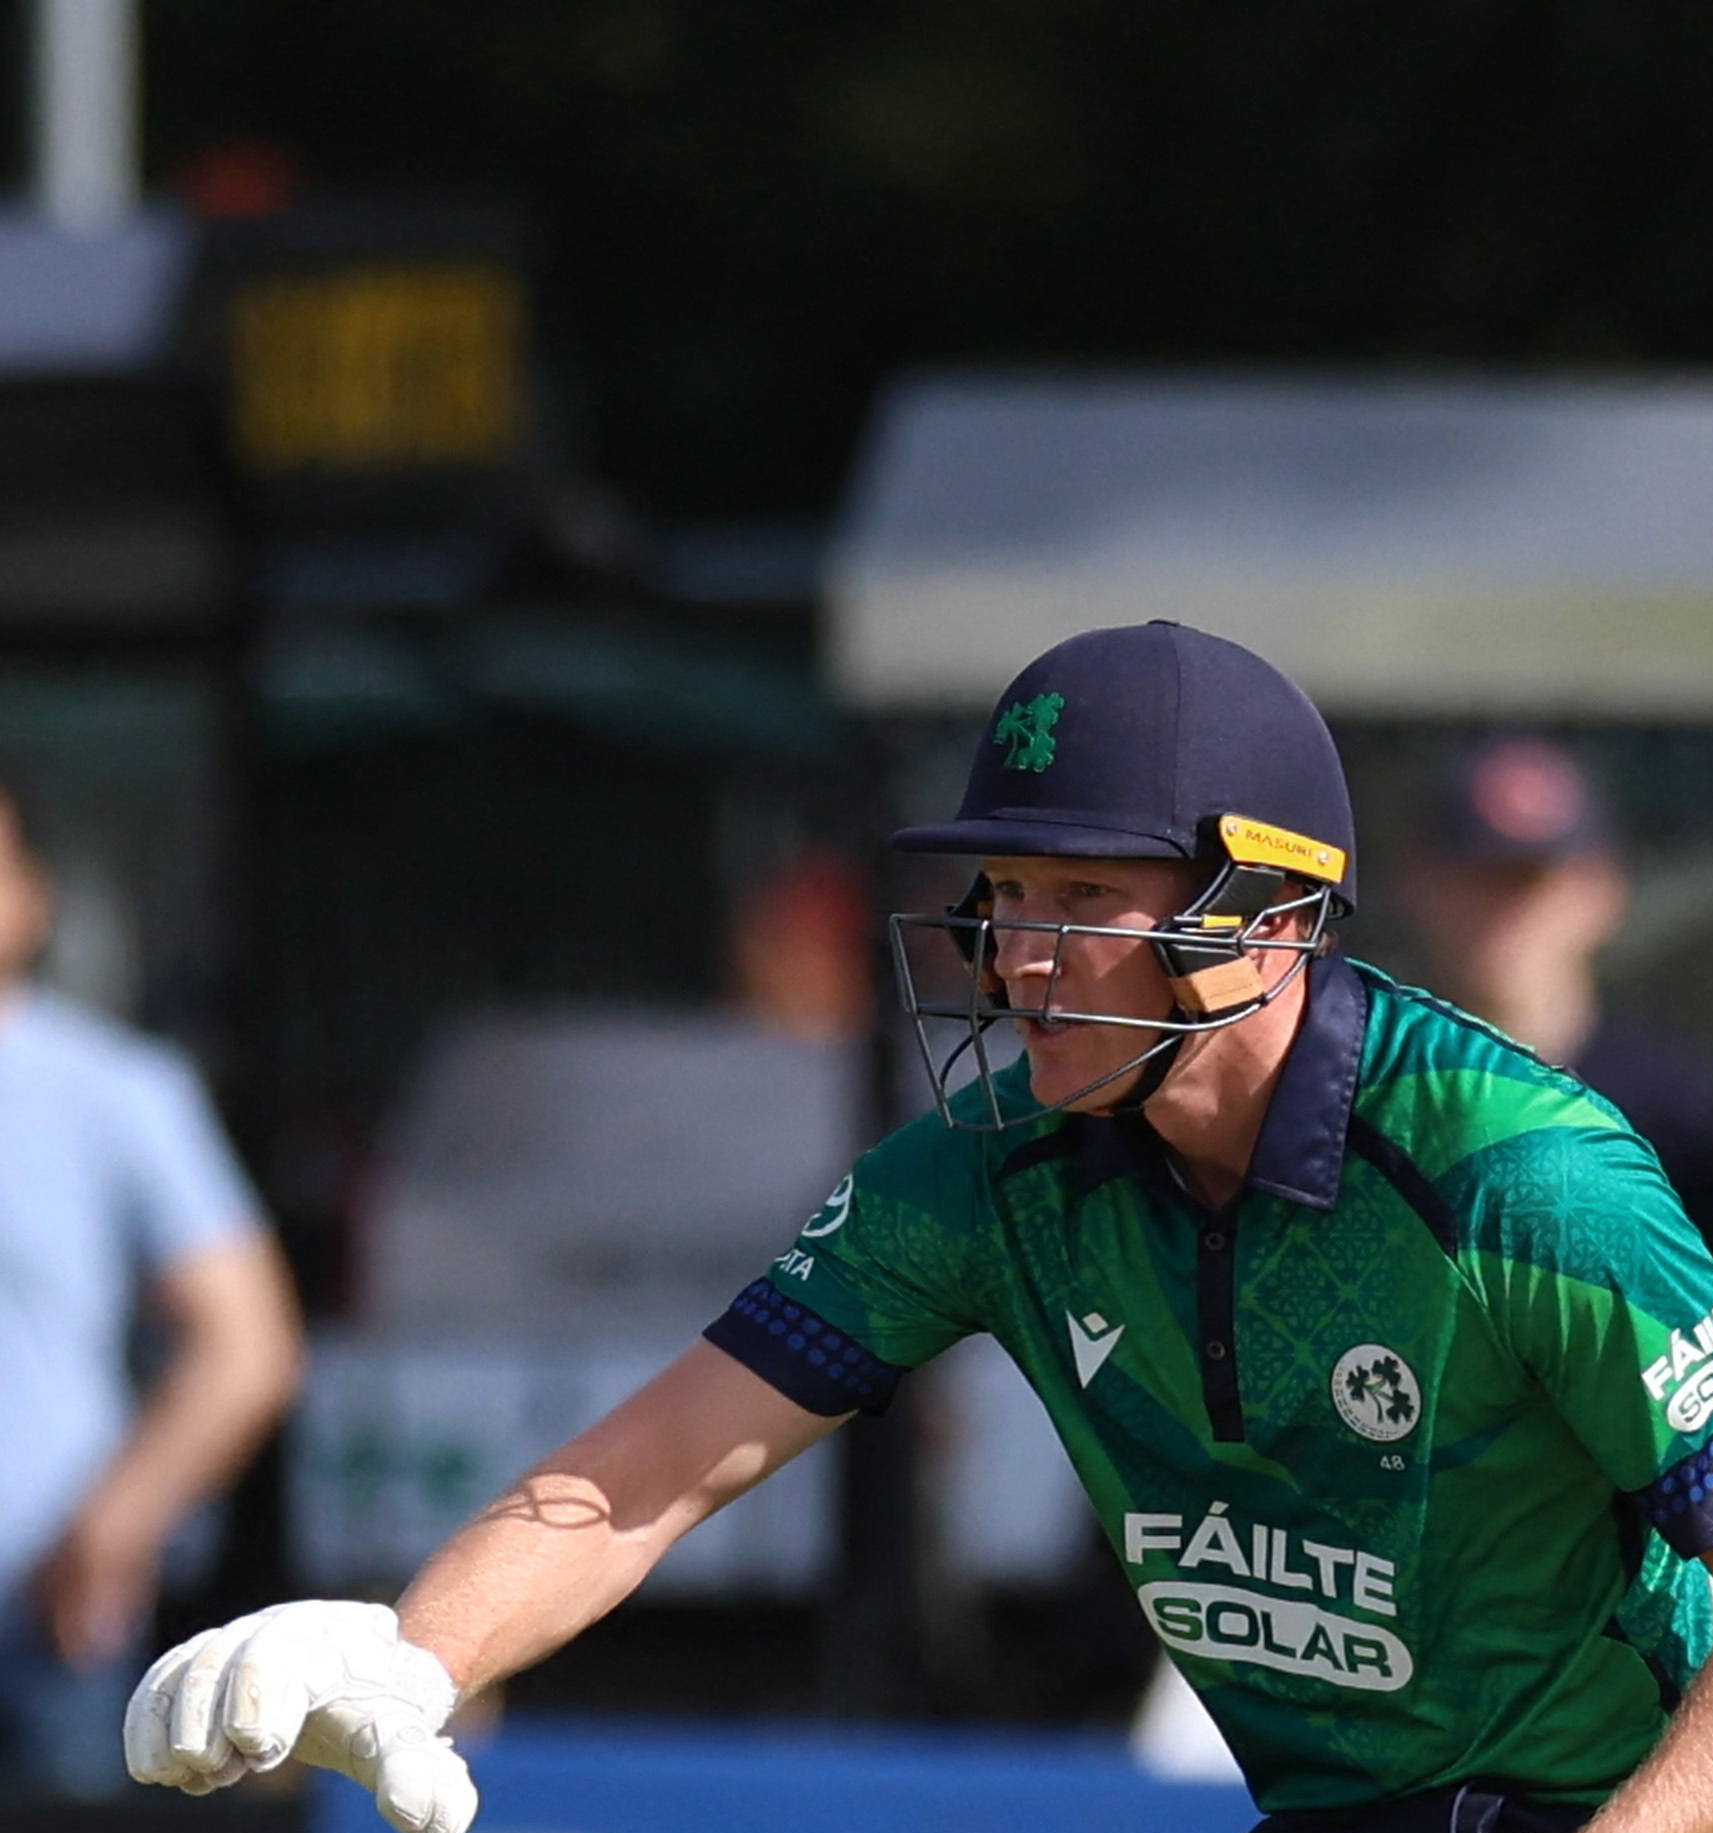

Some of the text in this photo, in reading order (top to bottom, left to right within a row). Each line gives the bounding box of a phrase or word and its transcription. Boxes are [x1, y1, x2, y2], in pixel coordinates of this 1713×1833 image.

[1246, 829, 1312, 857] MASURI
[1380, 1454, 1405, 1471] 48
[1123, 1500, 1398, 1617] FÁILTE
[1152, 1597, 1394, 1679] SOLAR
